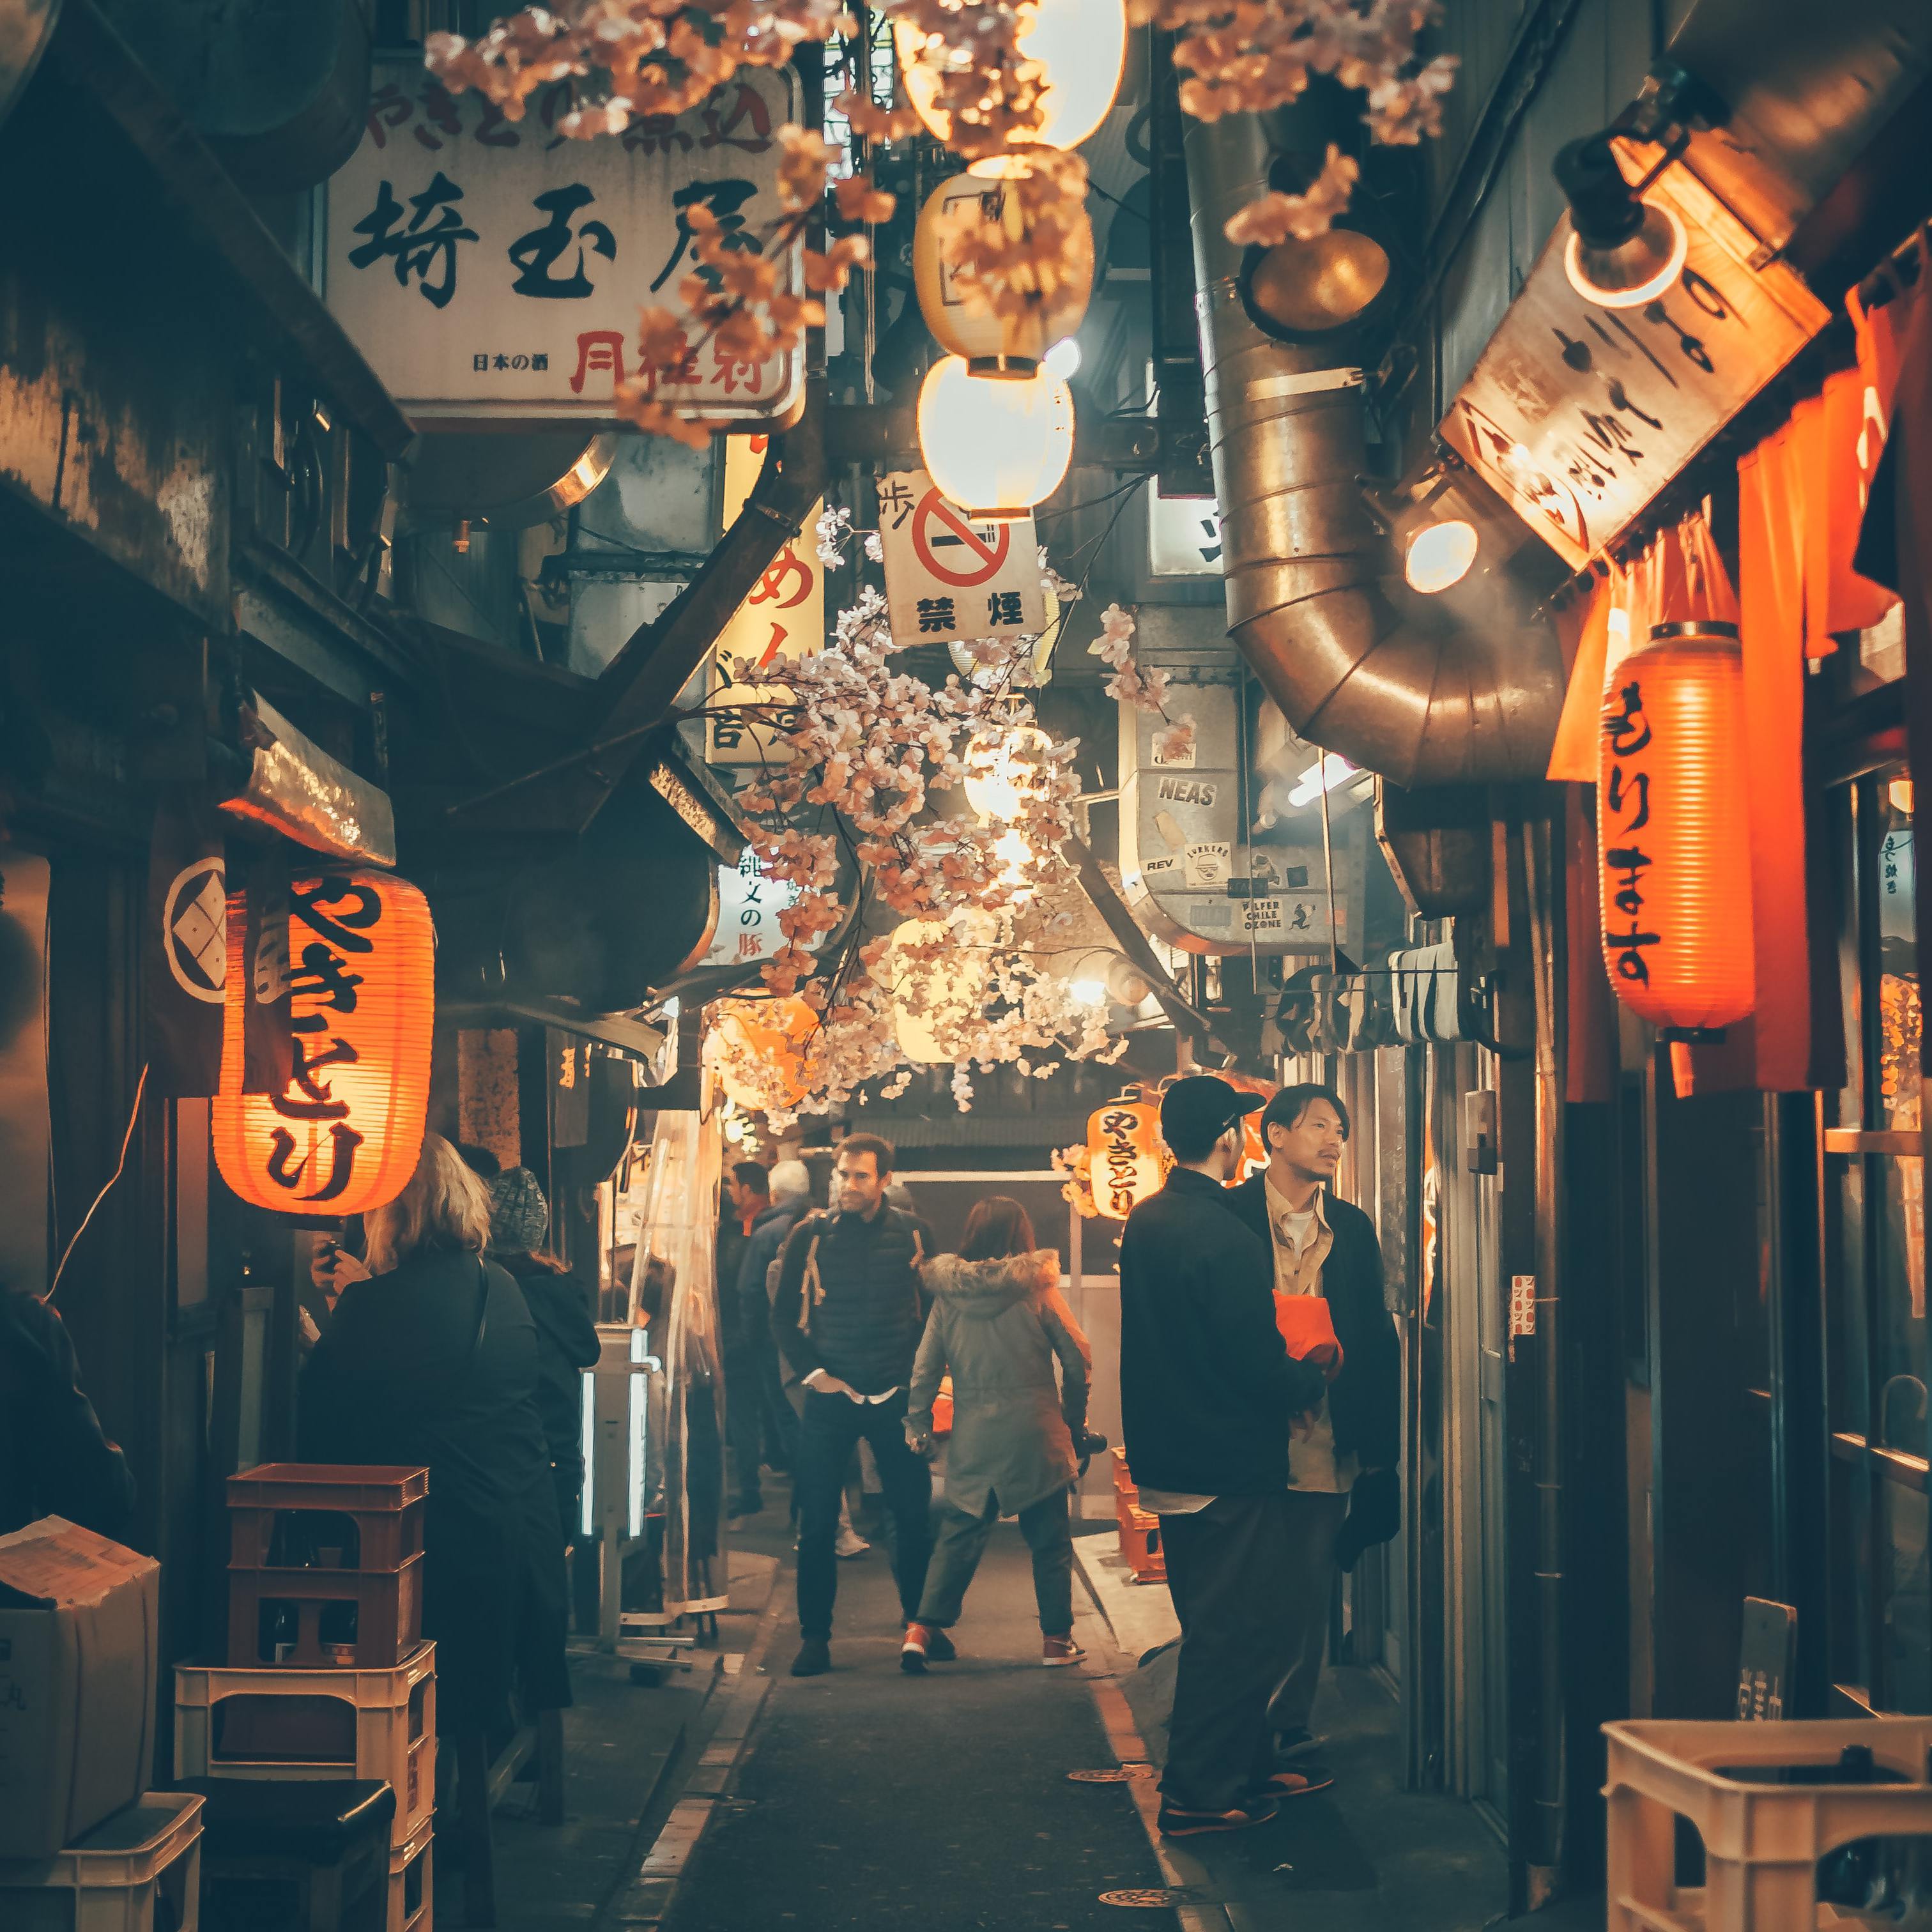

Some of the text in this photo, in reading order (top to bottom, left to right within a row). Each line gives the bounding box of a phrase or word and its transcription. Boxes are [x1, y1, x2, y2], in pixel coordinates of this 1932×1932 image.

[473, 353, 549, 372] 日本の酒
[916, 591, 1024, 633] 禁煙
[1147, 859, 1174, 871] REV
[1242, 901, 1279, 911] PLFER
[266, 876, 381, 1201] やきとり
[1103, 1111, 1138, 1214] やきとり
